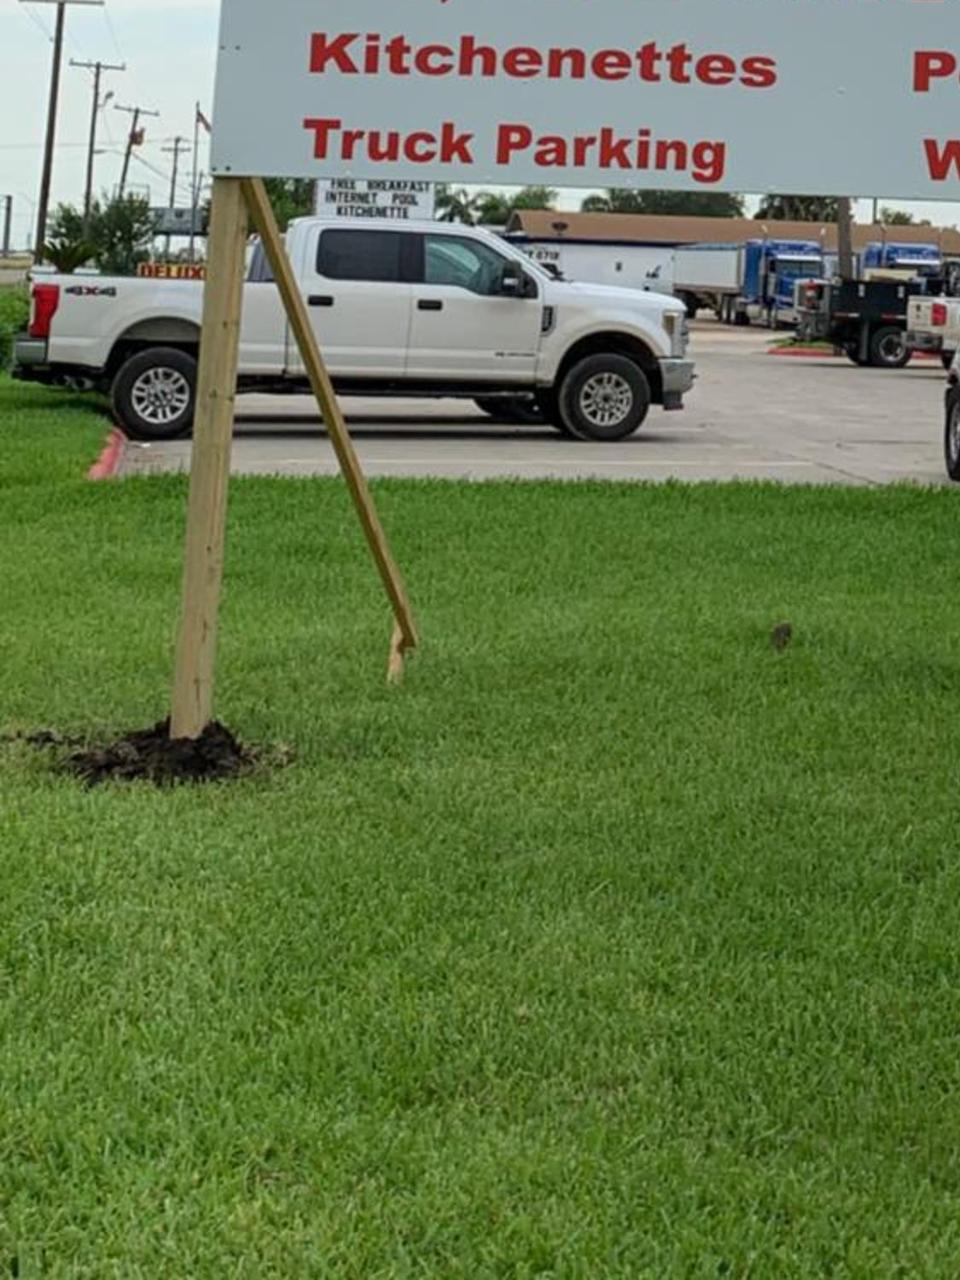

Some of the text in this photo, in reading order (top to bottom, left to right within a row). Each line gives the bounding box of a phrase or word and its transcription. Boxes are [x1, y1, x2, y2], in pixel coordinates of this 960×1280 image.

[308, 32, 776, 87] Kitchenettes
[303, 117, 727, 183] Truck Parking
[331, 178, 430, 191] FREE BREAKFAST
[325, 191, 418, 206] INTERNET POOL
[336, 206, 409, 219] KITCHENETTE
[140, 263, 208, 279] DELUX
